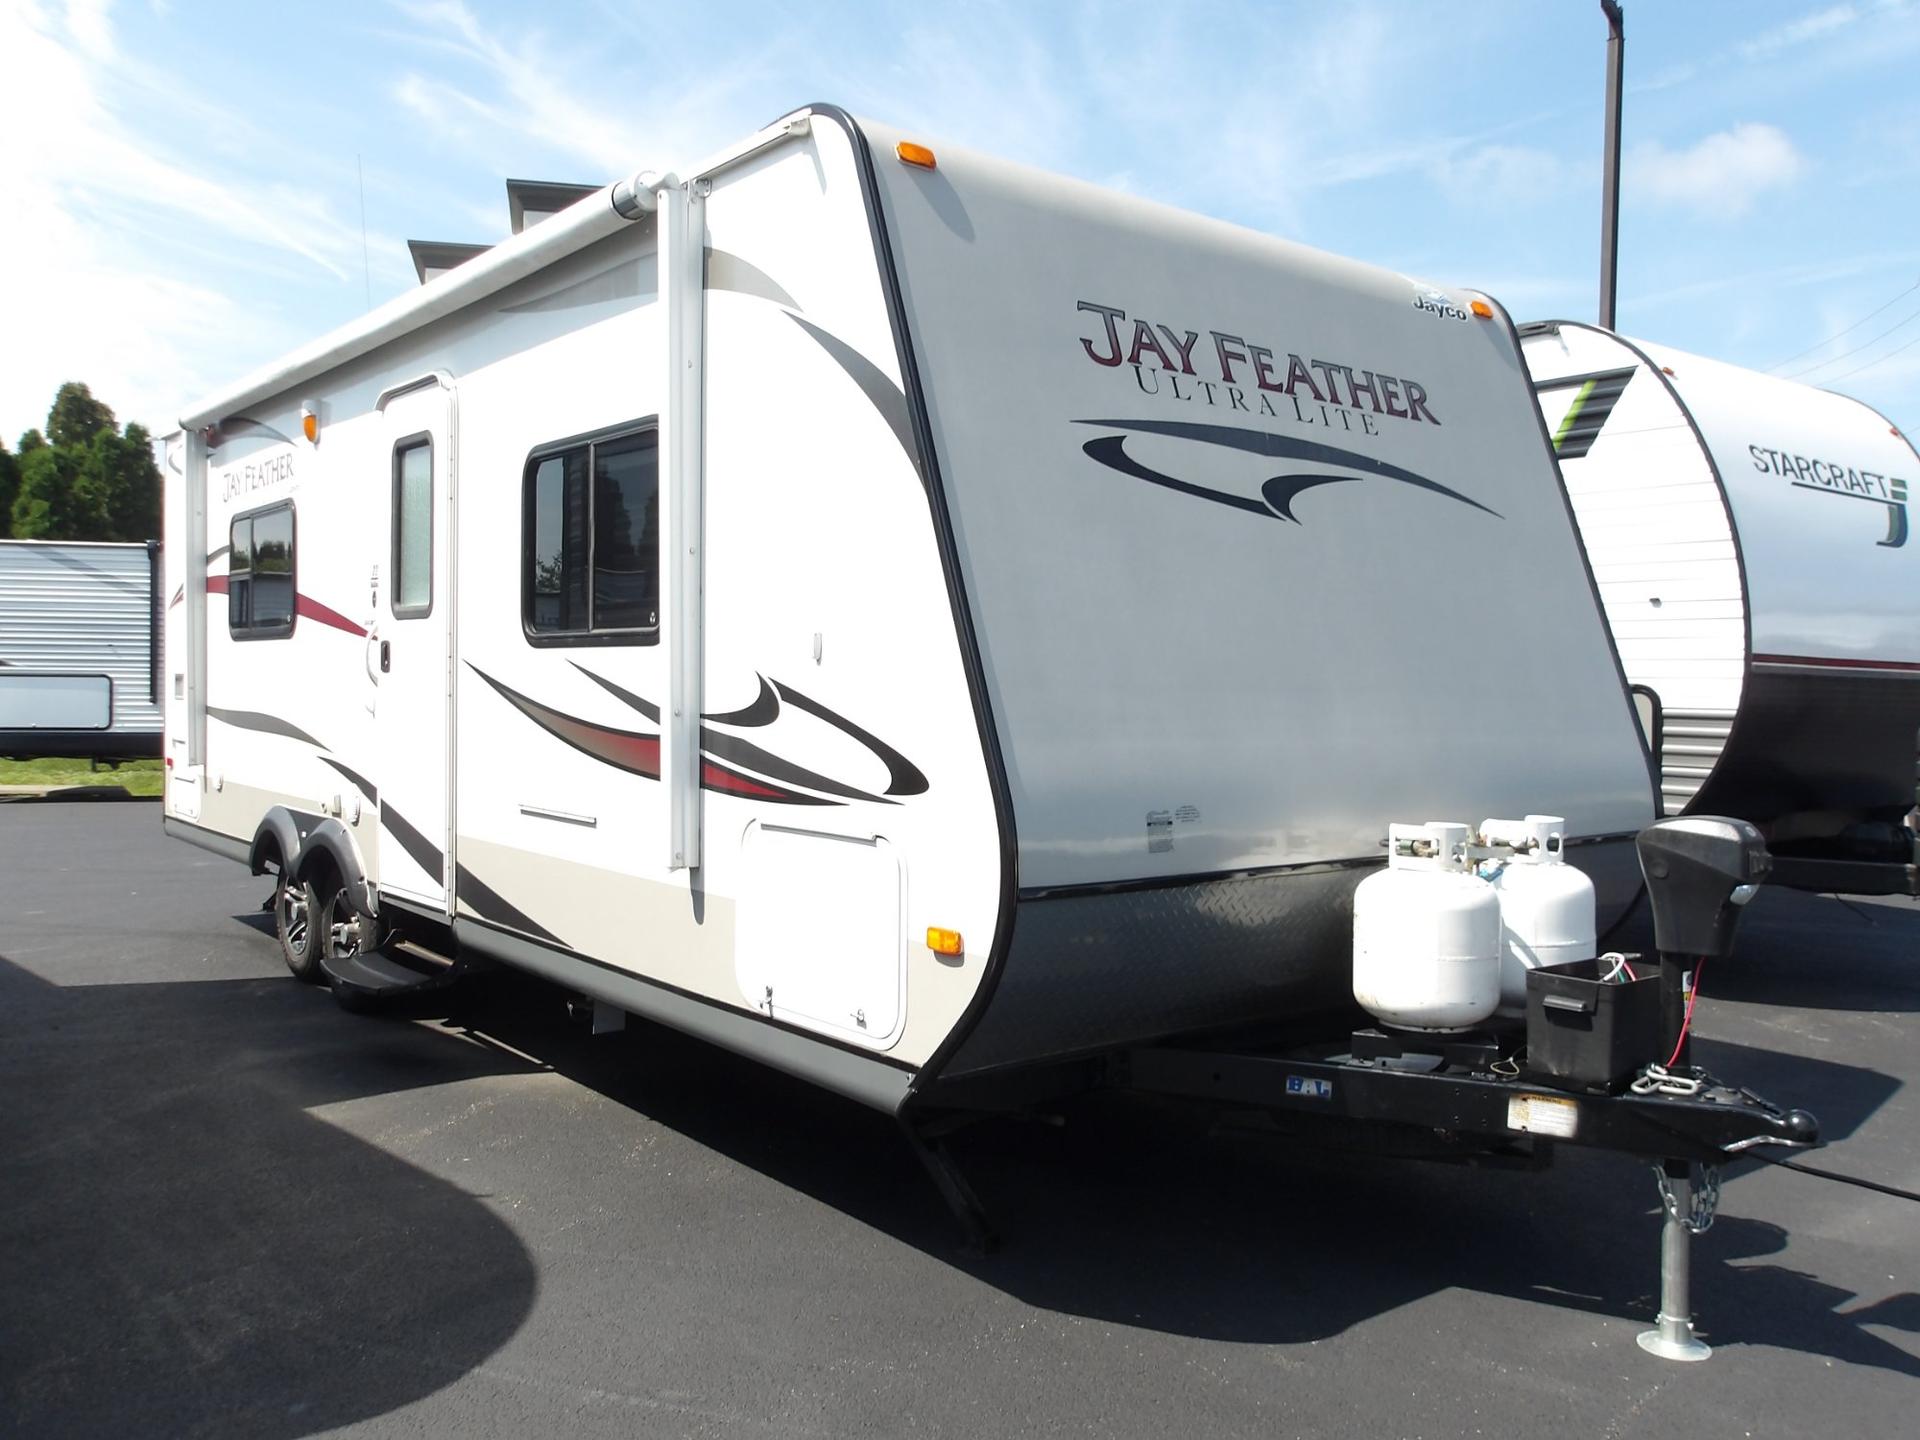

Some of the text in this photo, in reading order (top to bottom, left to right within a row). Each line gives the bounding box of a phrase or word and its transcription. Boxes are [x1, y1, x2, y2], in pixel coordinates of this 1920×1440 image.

[1413, 296, 1467, 321] Jayco
[1077, 300, 1442, 426] JAY FEATHER
[1131, 363, 1379, 436] ULTRA LITE
[223, 453, 294, 503] JAY FEATHER
[1749, 444, 1888, 498] STARCRAFT
